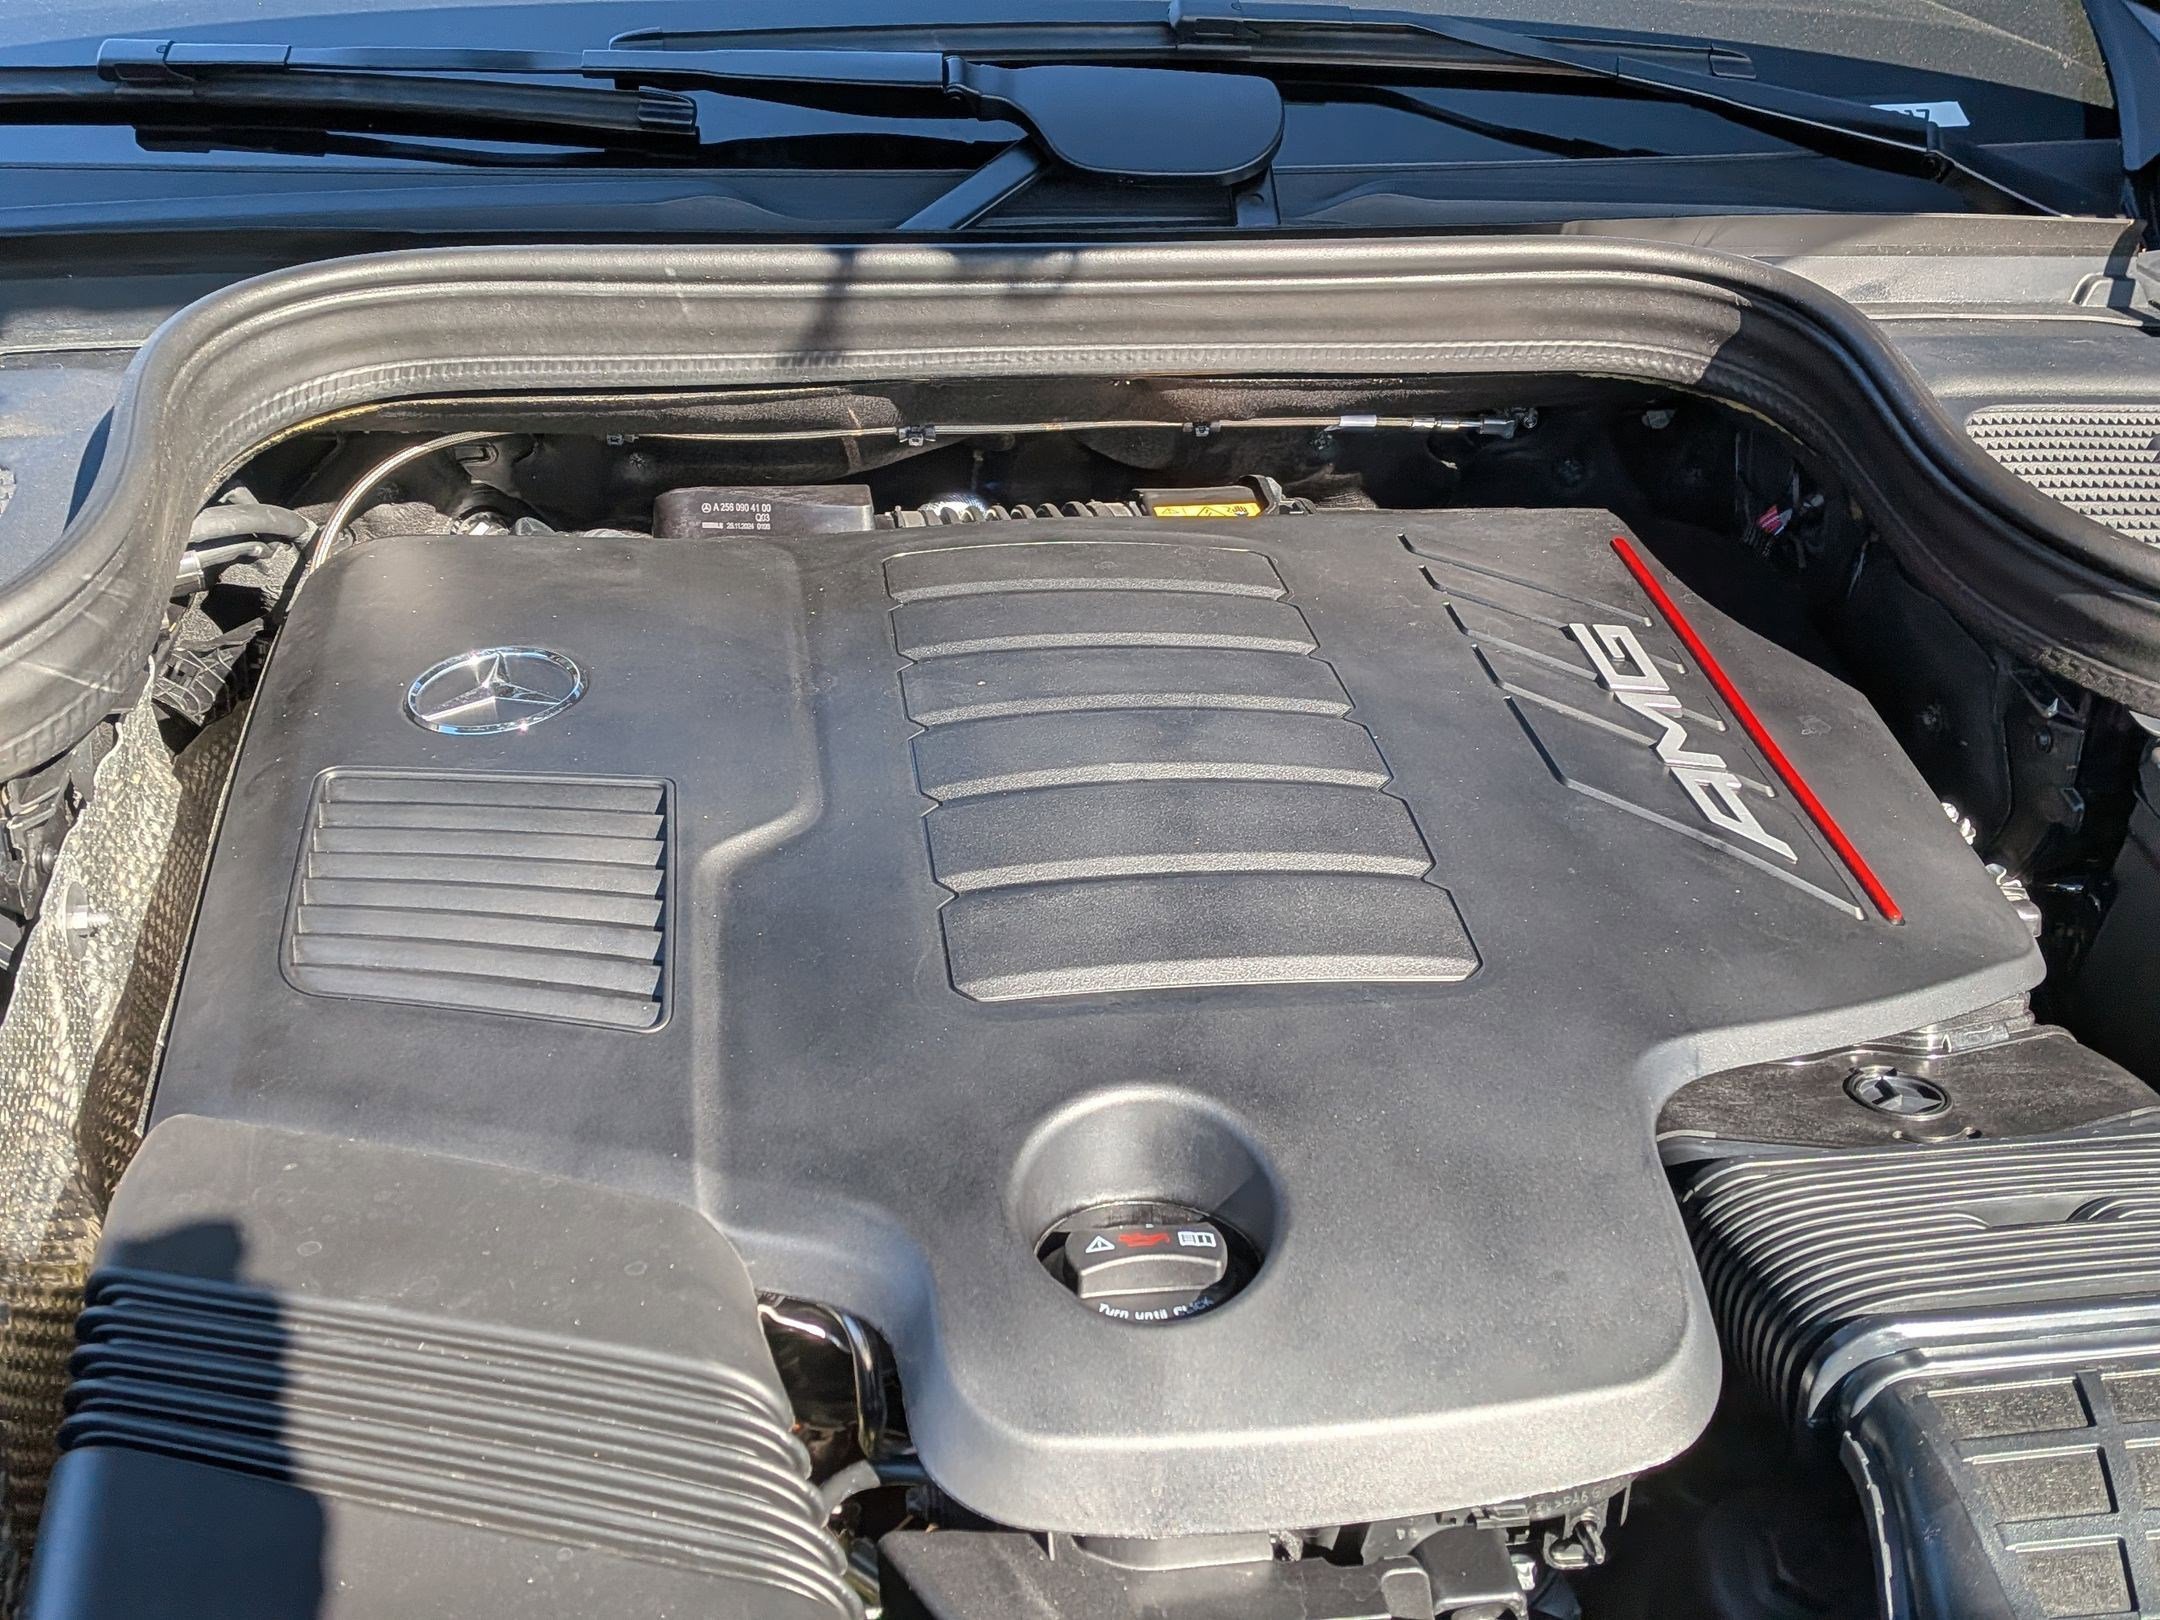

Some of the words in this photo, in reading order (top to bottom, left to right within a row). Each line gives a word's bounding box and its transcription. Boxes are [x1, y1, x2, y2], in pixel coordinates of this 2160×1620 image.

[712, 502, 720, 512] A
[735, 503, 750, 512] 090
[750, 503, 760, 513] 41
[761, 503, 772, 513] 00
[1566, 622, 1799, 866] AMG
[1098, 1302, 1130, 1320] Turn
[1134, 1308, 1169, 1321] until
